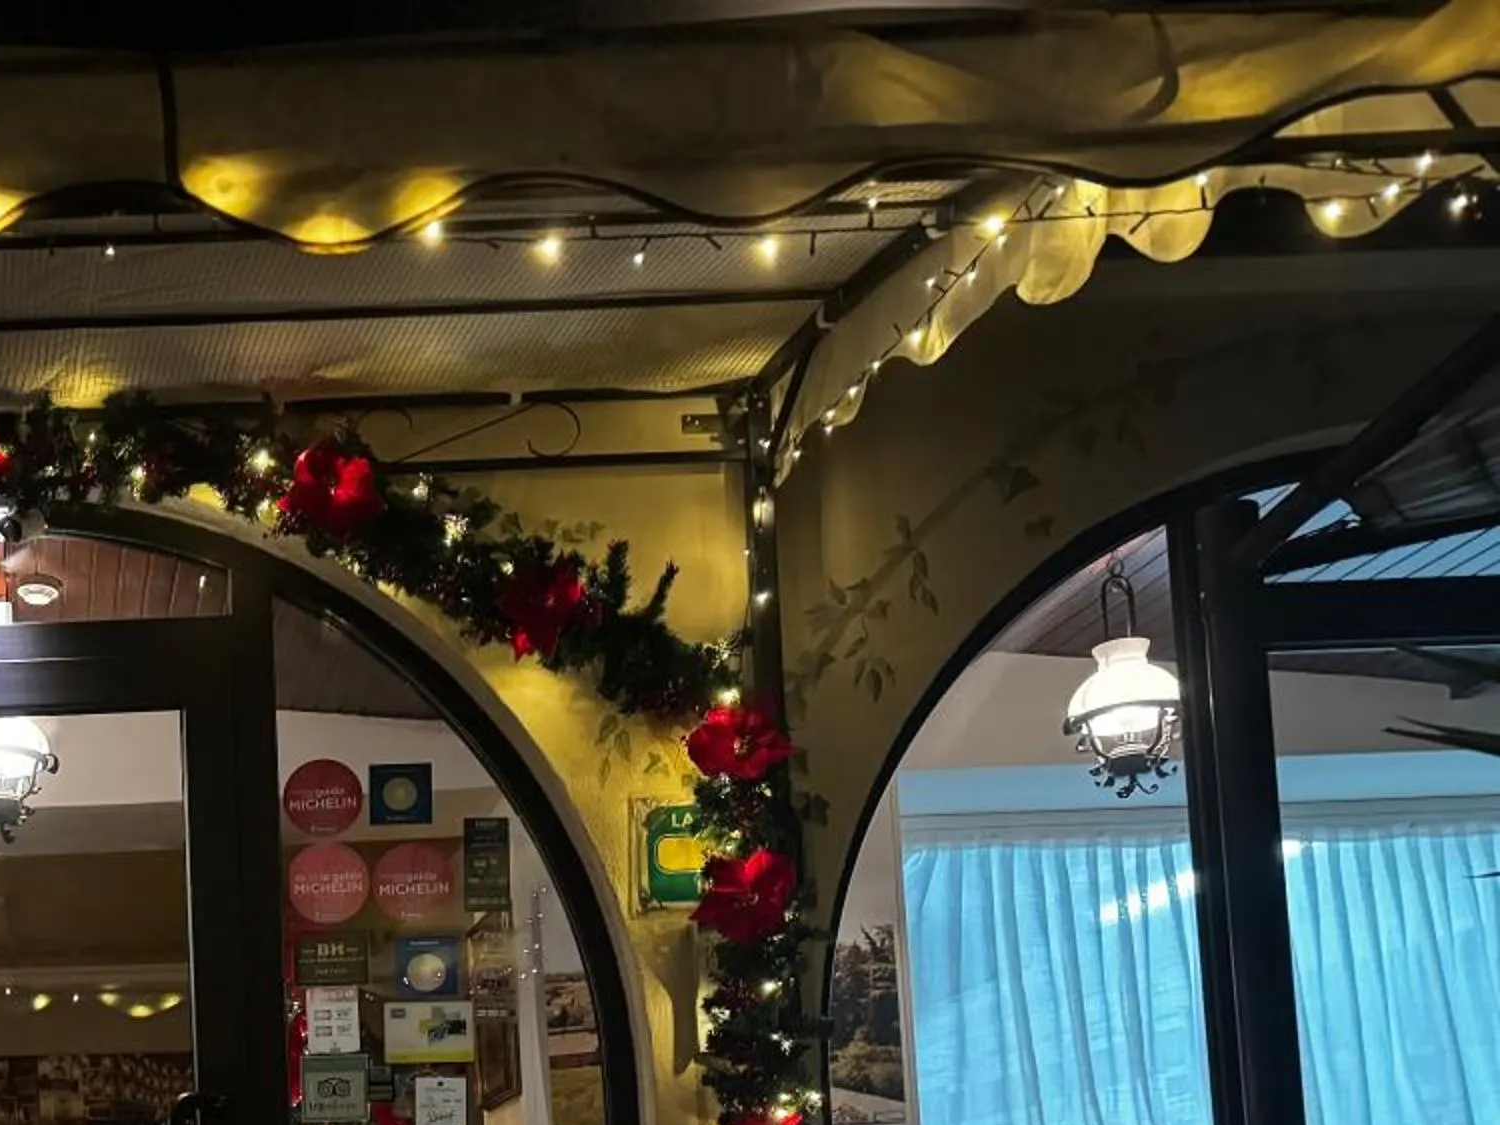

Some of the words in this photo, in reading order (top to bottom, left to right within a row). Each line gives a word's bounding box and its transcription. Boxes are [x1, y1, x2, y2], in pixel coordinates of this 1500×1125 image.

[289, 795, 357, 811] MICHELIN
[293, 880, 363, 895] MICHELIN
[379, 881, 449, 896] MICHELIN
